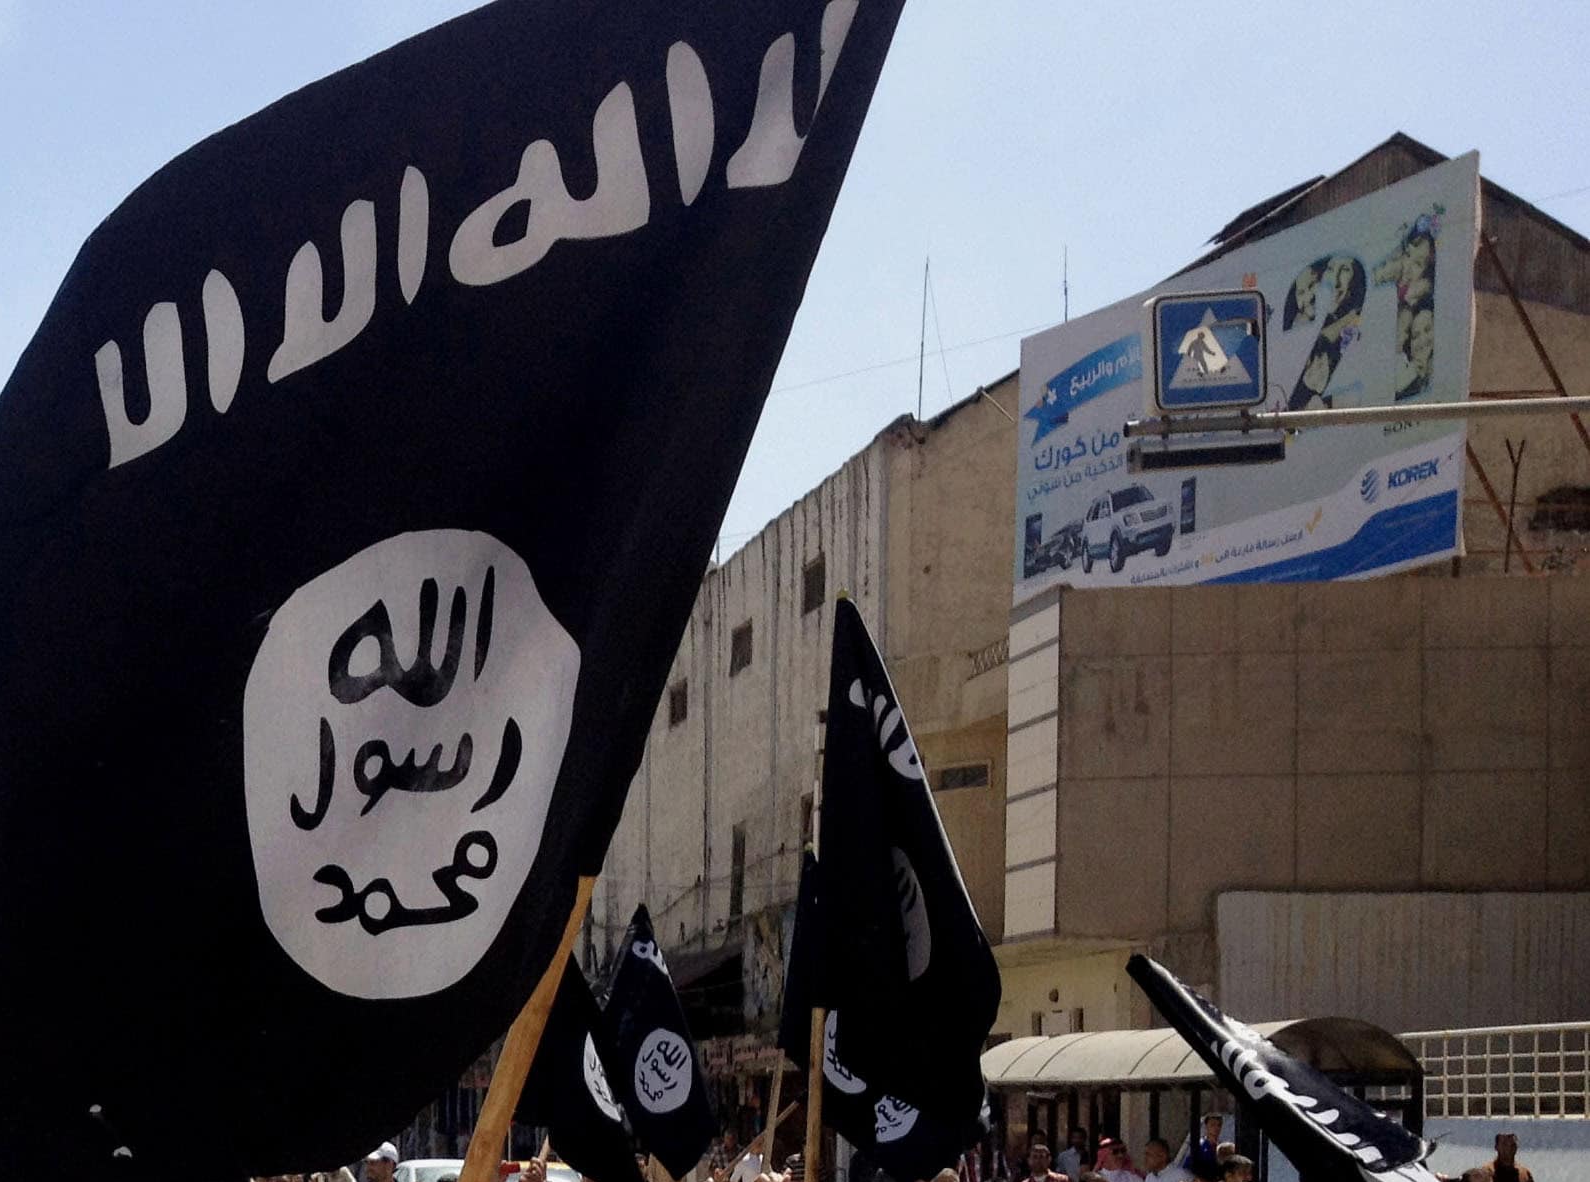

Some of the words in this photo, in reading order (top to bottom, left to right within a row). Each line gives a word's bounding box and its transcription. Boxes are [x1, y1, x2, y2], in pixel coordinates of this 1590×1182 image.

[1283, 220, 1438, 411] 21
[1035, 436, 1087, 472] كورك
[1091, 431, 1120, 456] من
[1387, 458, 1439, 490] KOREK
[328, 565, 495, 708] الله
[290, 716, 523, 831] رسول
[312, 829, 499, 937] محمد
[642, 1048, 678, 1091] رسول
[656, 1040, 688, 1071] الله
[638, 1069, 664, 1102] محمد
